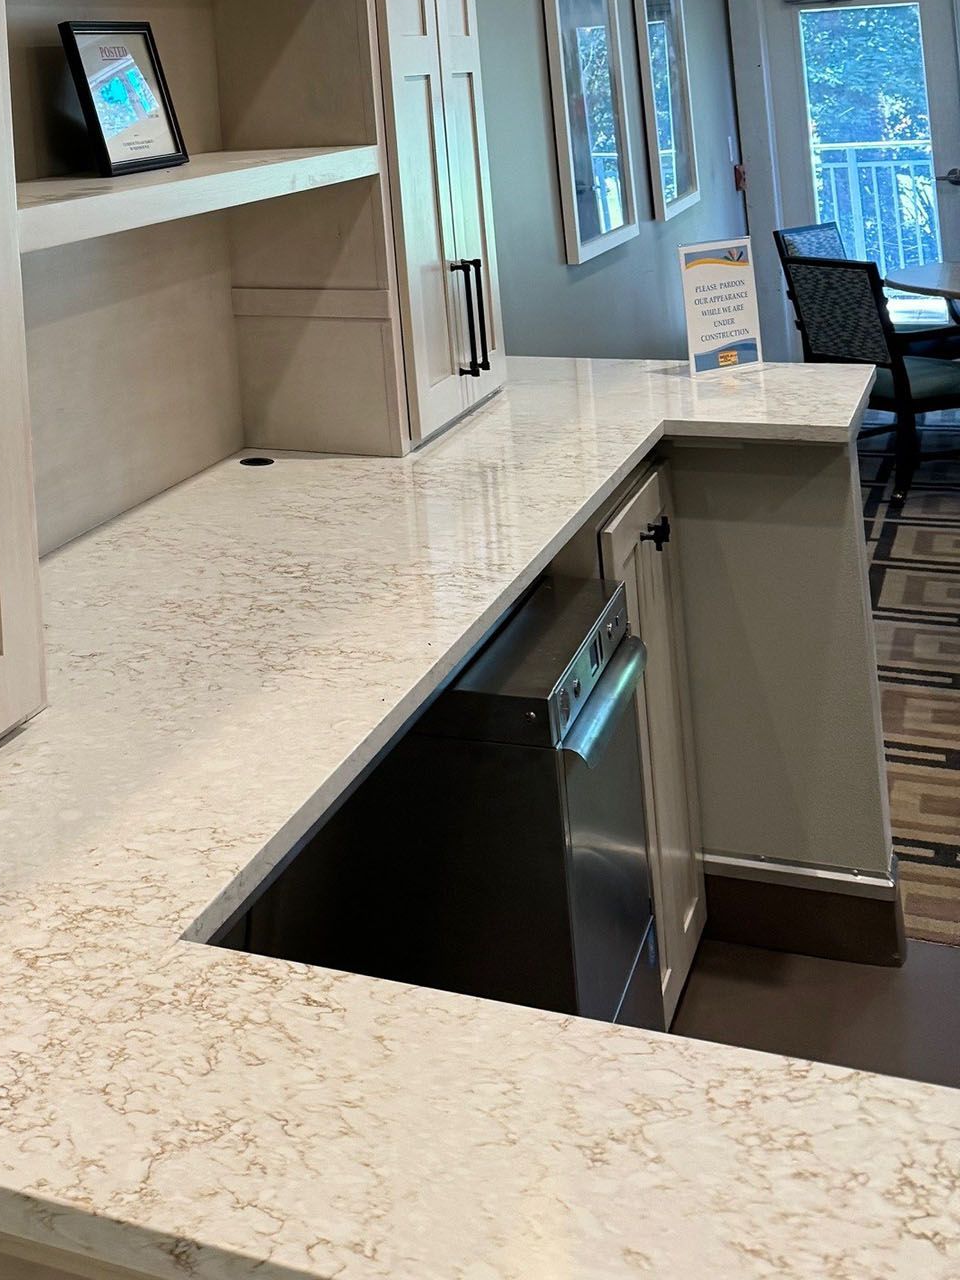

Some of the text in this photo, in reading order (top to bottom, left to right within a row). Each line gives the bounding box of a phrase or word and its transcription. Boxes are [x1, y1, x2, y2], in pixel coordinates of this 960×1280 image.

[99, 46, 128, 58] POSTED
[695, 279, 745, 293] PLEASE PARDON
[694, 291, 748, 306] OUR APPEARANCE
[701, 303, 744, 316] WHILE WE ARE
[713, 317, 735, 328] UNDER
[700, 328, 749, 343] CONSTRUCTION
